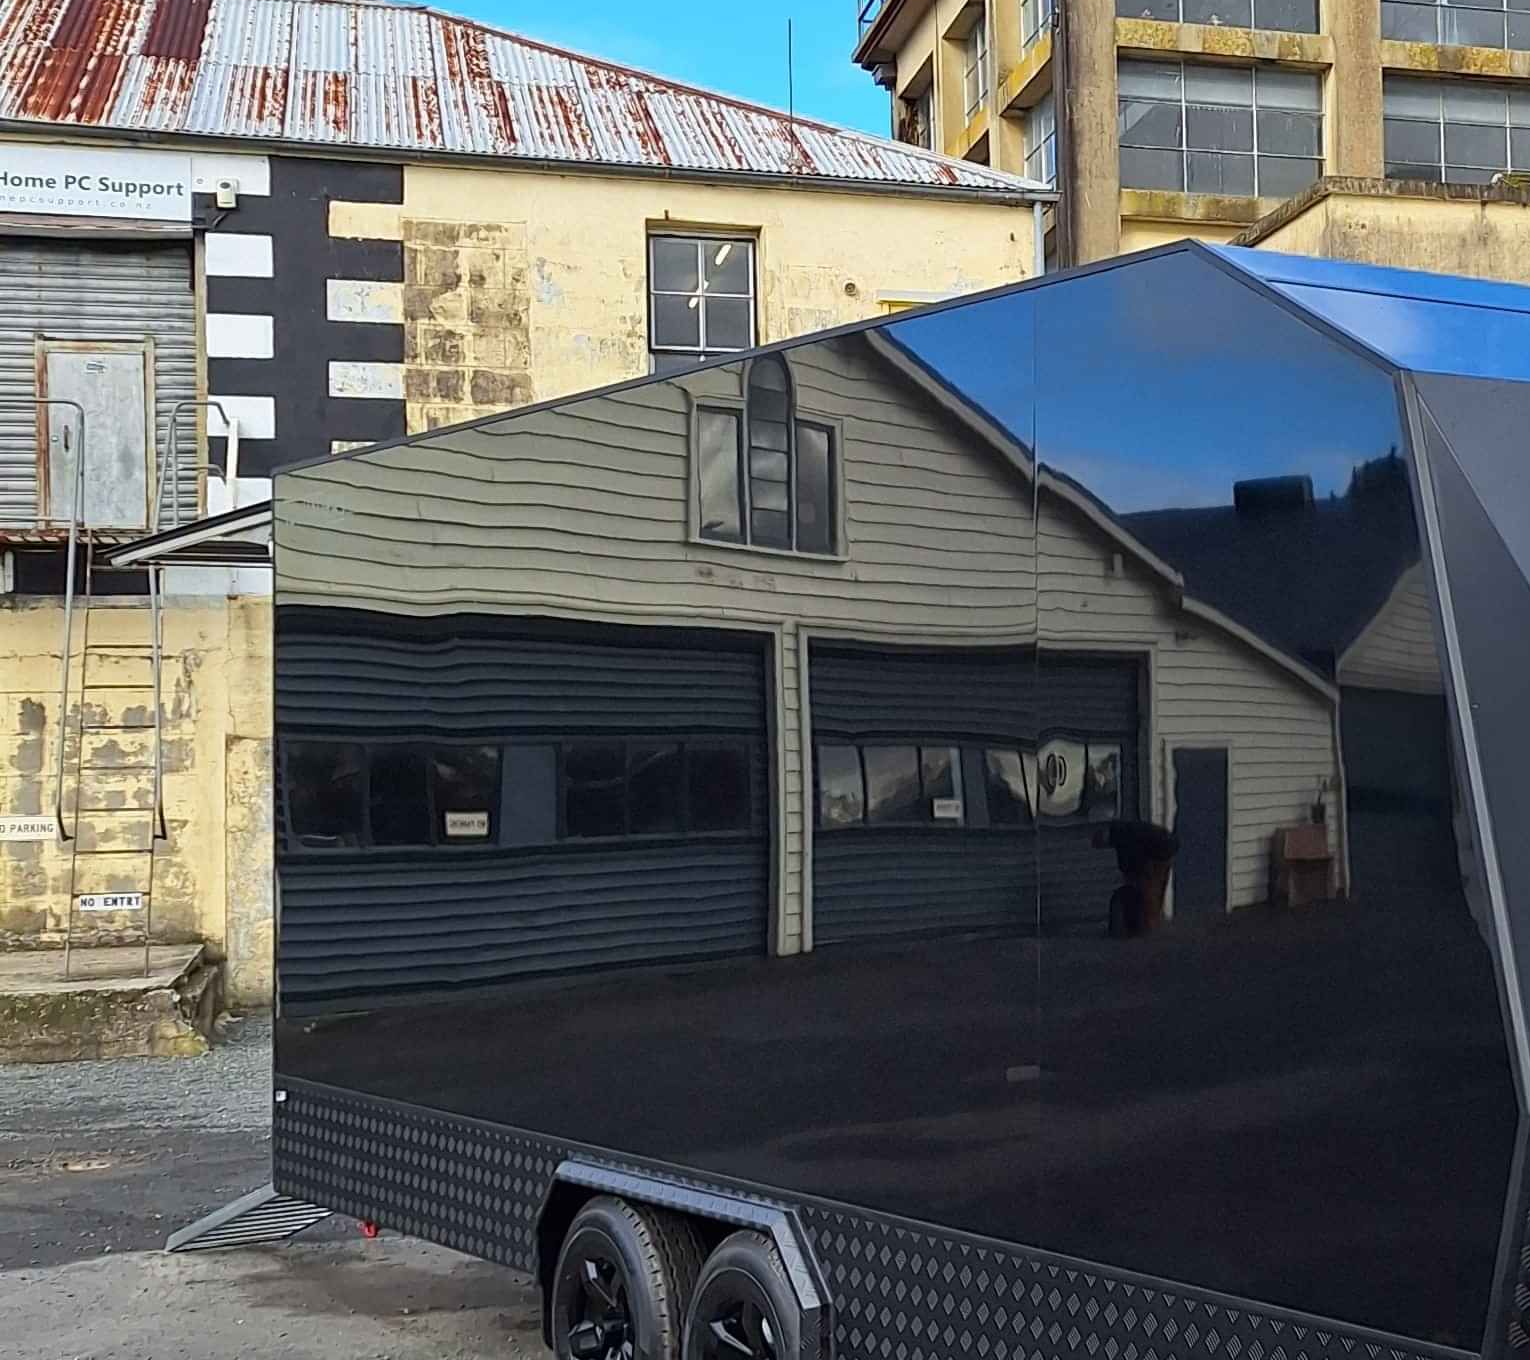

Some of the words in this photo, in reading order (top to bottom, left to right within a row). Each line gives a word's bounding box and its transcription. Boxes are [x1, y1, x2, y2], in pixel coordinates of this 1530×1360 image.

[65, 175, 91, 191] PC
[99, 177, 184, 198] Support
[10, 823, 54, 833] PARKING
[80, 898, 95, 906] NO
